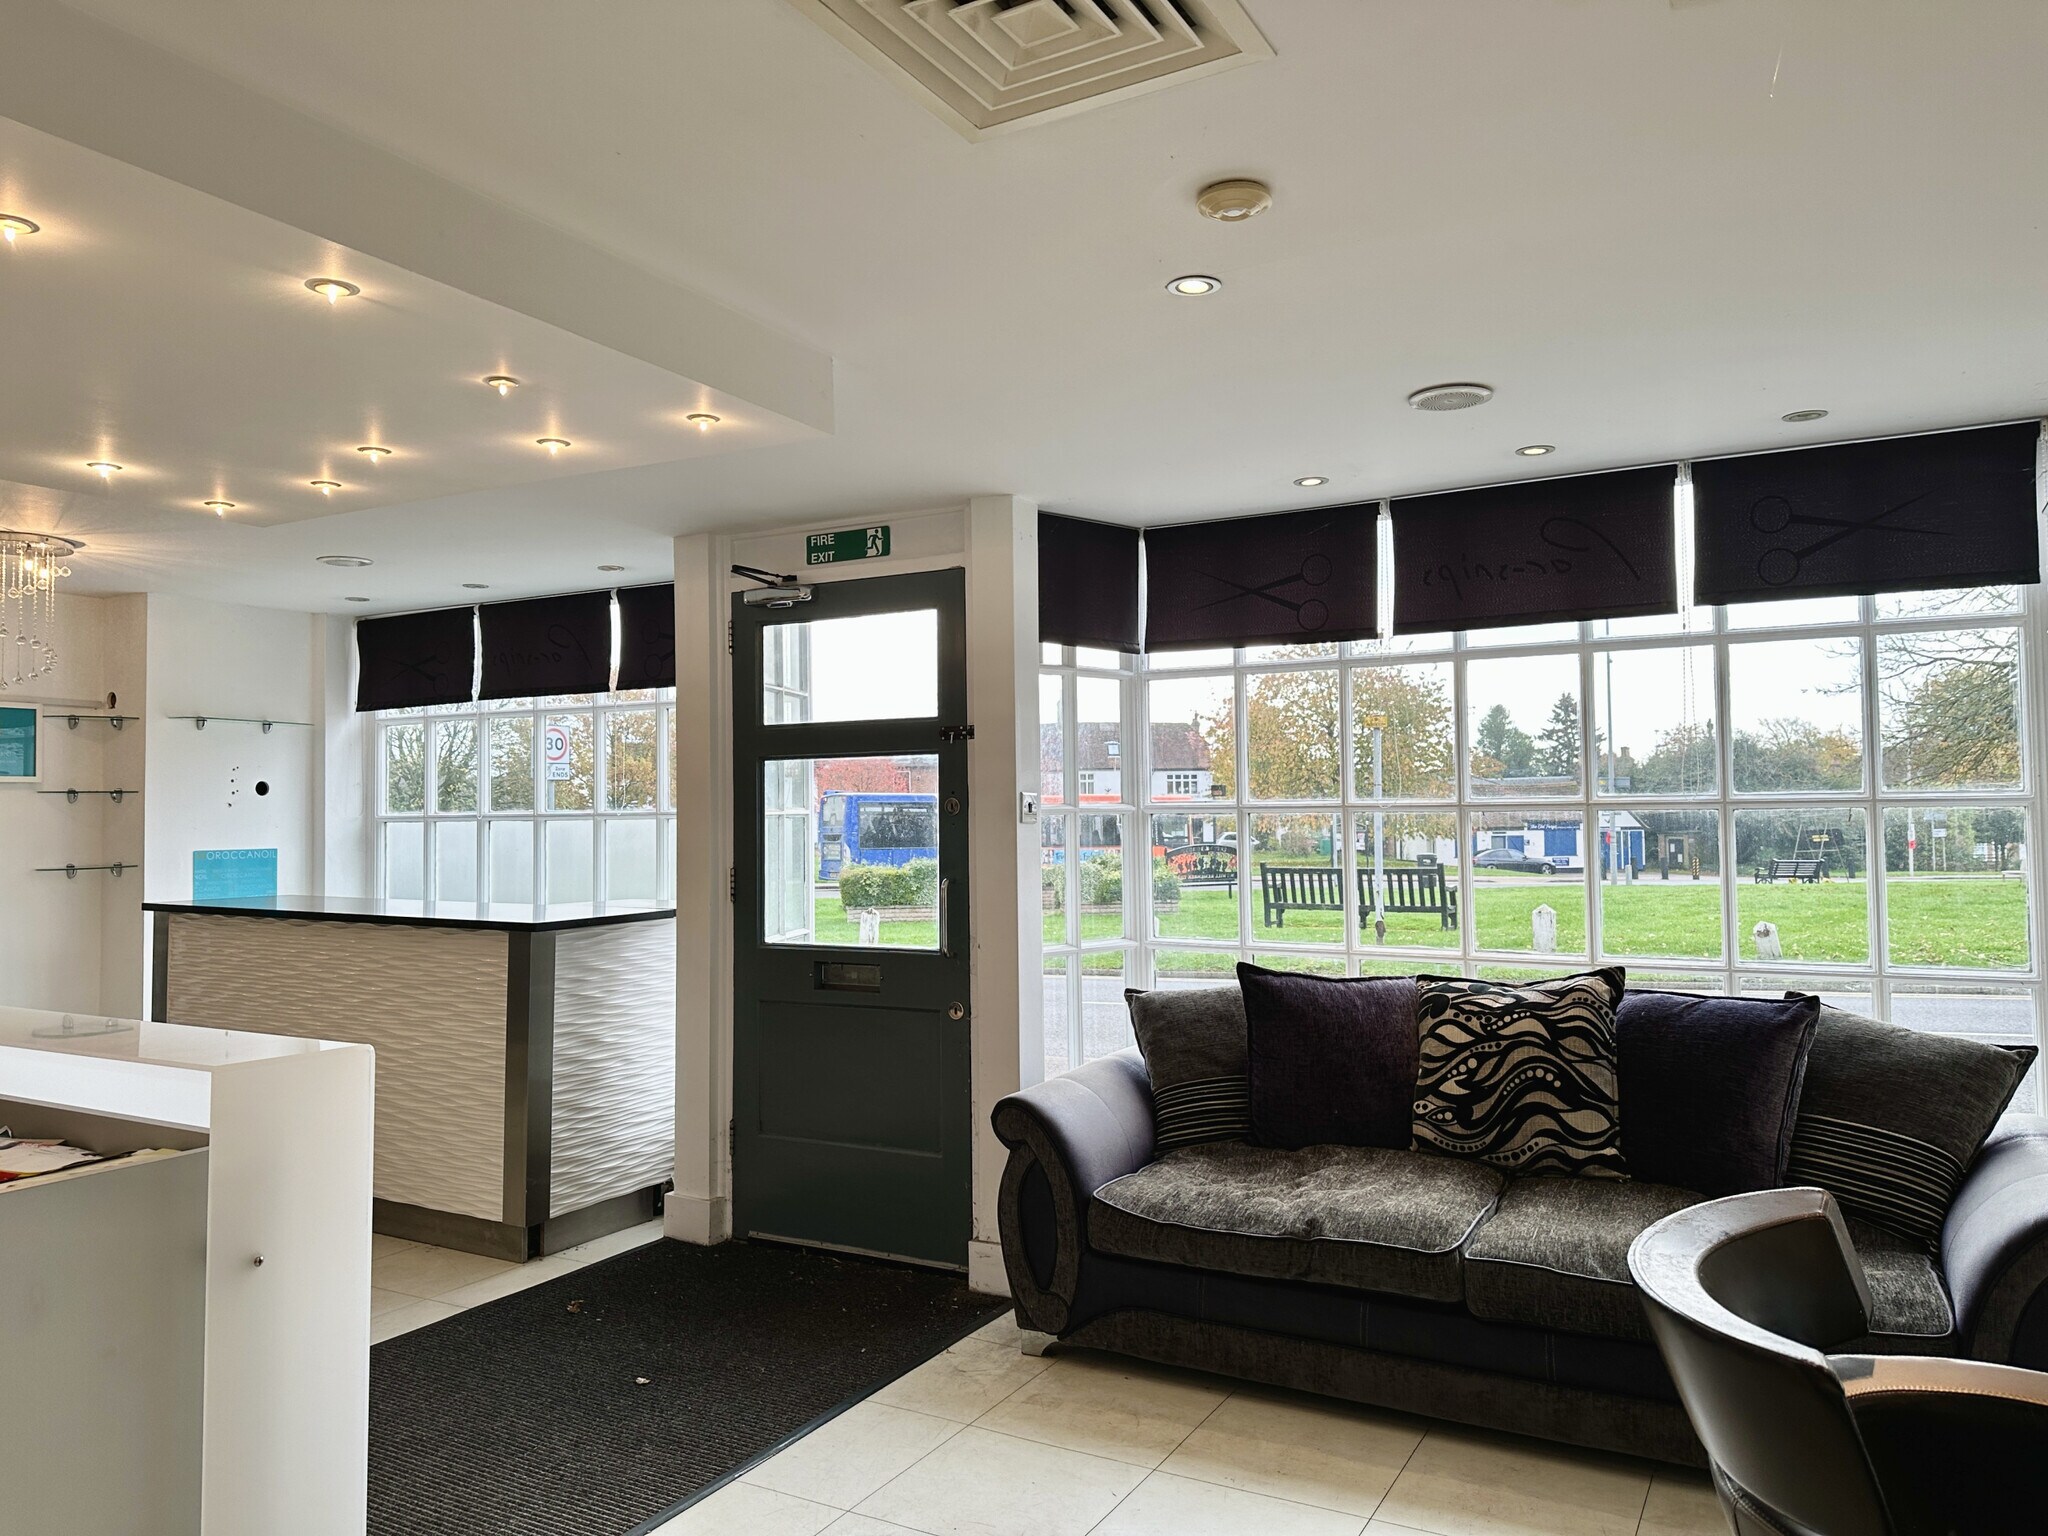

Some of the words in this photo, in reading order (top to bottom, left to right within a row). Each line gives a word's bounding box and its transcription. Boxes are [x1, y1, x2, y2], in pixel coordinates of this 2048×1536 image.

[811, 534, 835, 547] FIRE
[811, 551, 835, 564] EXIT
[546, 737, 564, 750] 30
